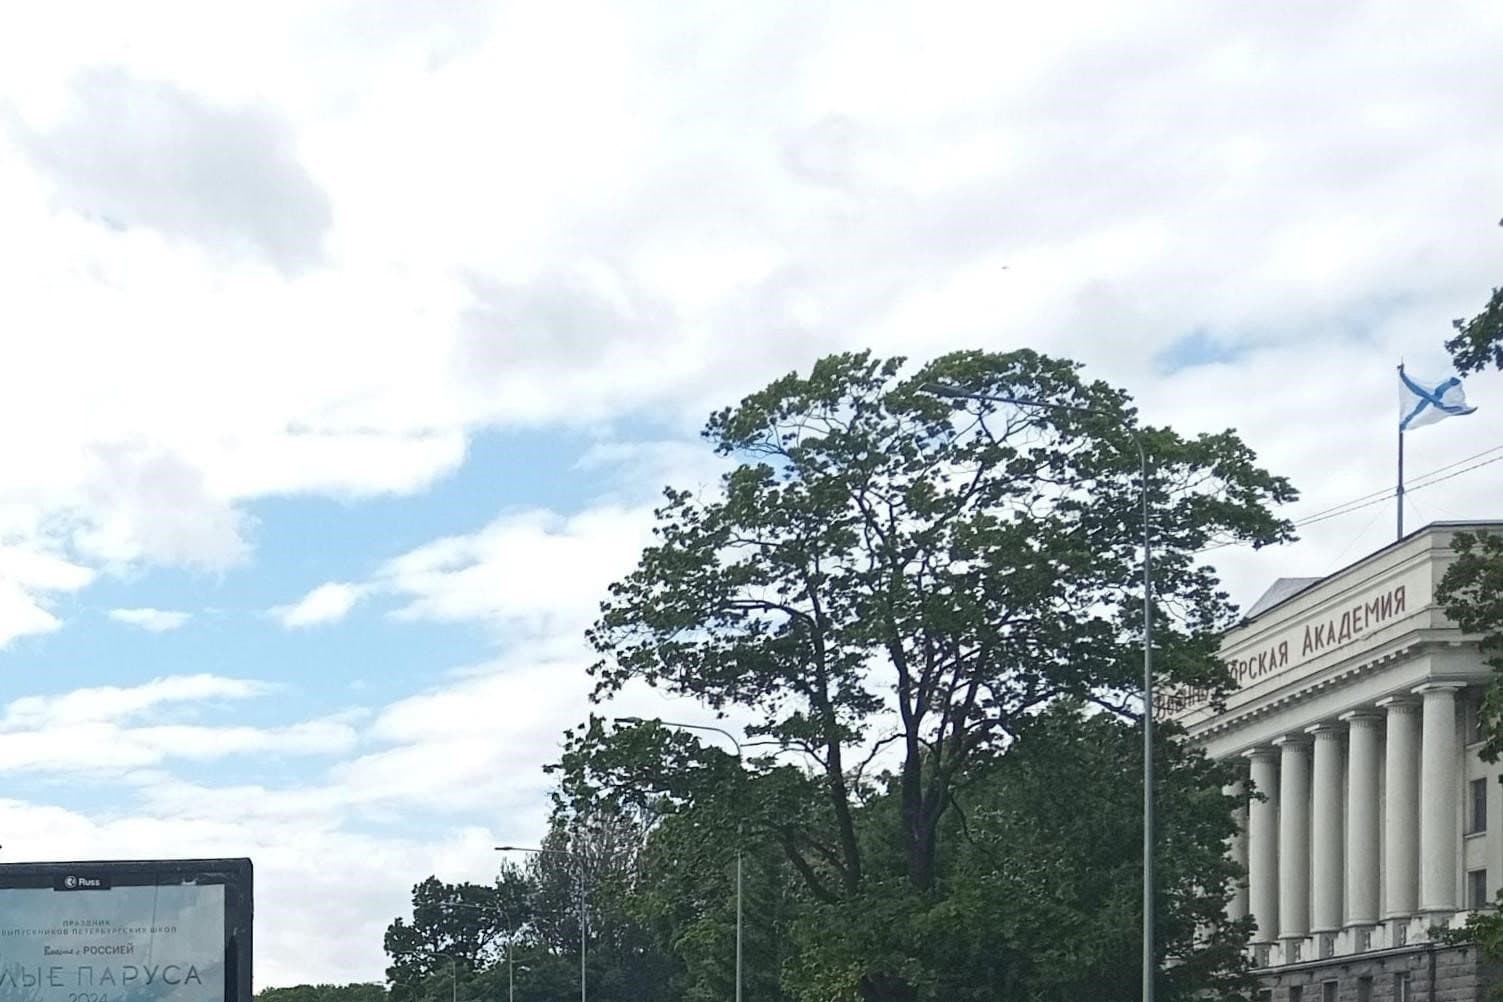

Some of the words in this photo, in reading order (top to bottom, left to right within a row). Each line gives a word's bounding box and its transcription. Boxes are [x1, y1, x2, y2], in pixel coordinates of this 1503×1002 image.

[1302, 585, 1406, 656] АКАДЕМИЯ
[78, 877, 101, 887] Russ
[62, 919, 112, 928] ПРАЗДНИК
[82, 942, 135, 956] РОССИЕЙ
[76, 963, 203, 987] ПАРУСА
